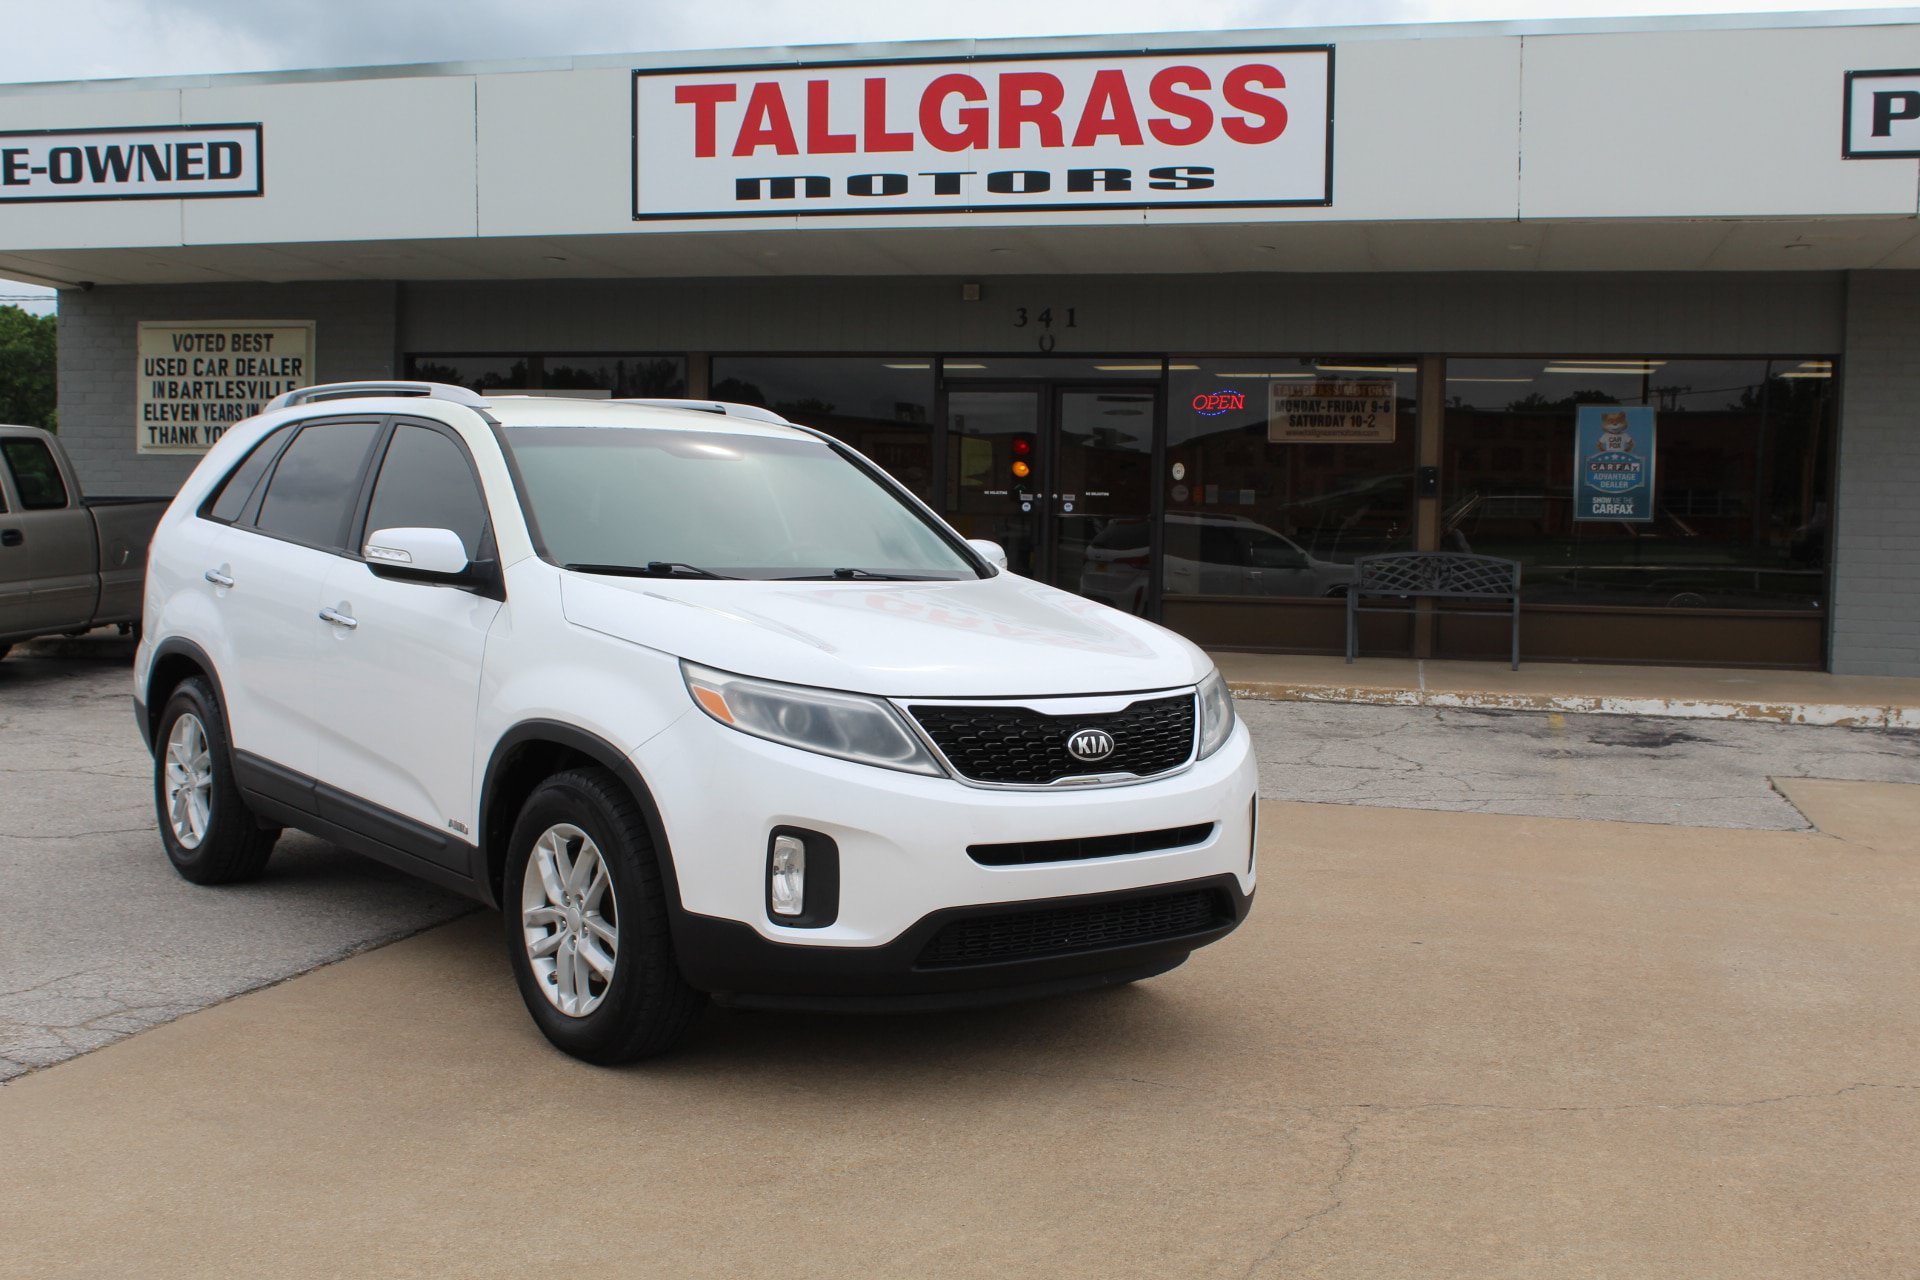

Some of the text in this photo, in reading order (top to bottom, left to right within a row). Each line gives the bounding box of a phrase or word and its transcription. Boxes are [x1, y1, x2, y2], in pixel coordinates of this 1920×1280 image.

[674, 63, 1289, 158] TALLGRASS
[735, 165, 1215, 201] MOTORS
[172, 333, 274, 353] VOTED BEST
[145, 357, 302, 377] USED CAR DEALER
[152, 381, 165, 399] IN
[1192, 393, 1245, 411] OPEN
[144, 403, 200, 422] ELEVEN
[203, 403, 243, 422] YEARS
[1289, 413, 1376, 428] SATURDAY 10-2
[148, 425, 228, 445] THANK YO
[1591, 463, 1640, 472] CARFAX
[1593, 473, 1636, 481] ADVANTAGE
[1600, 481, 1629, 489] DEALER
[1592, 503, 1634, 514] CARFAX
[1076, 735, 1109, 755] KIA
